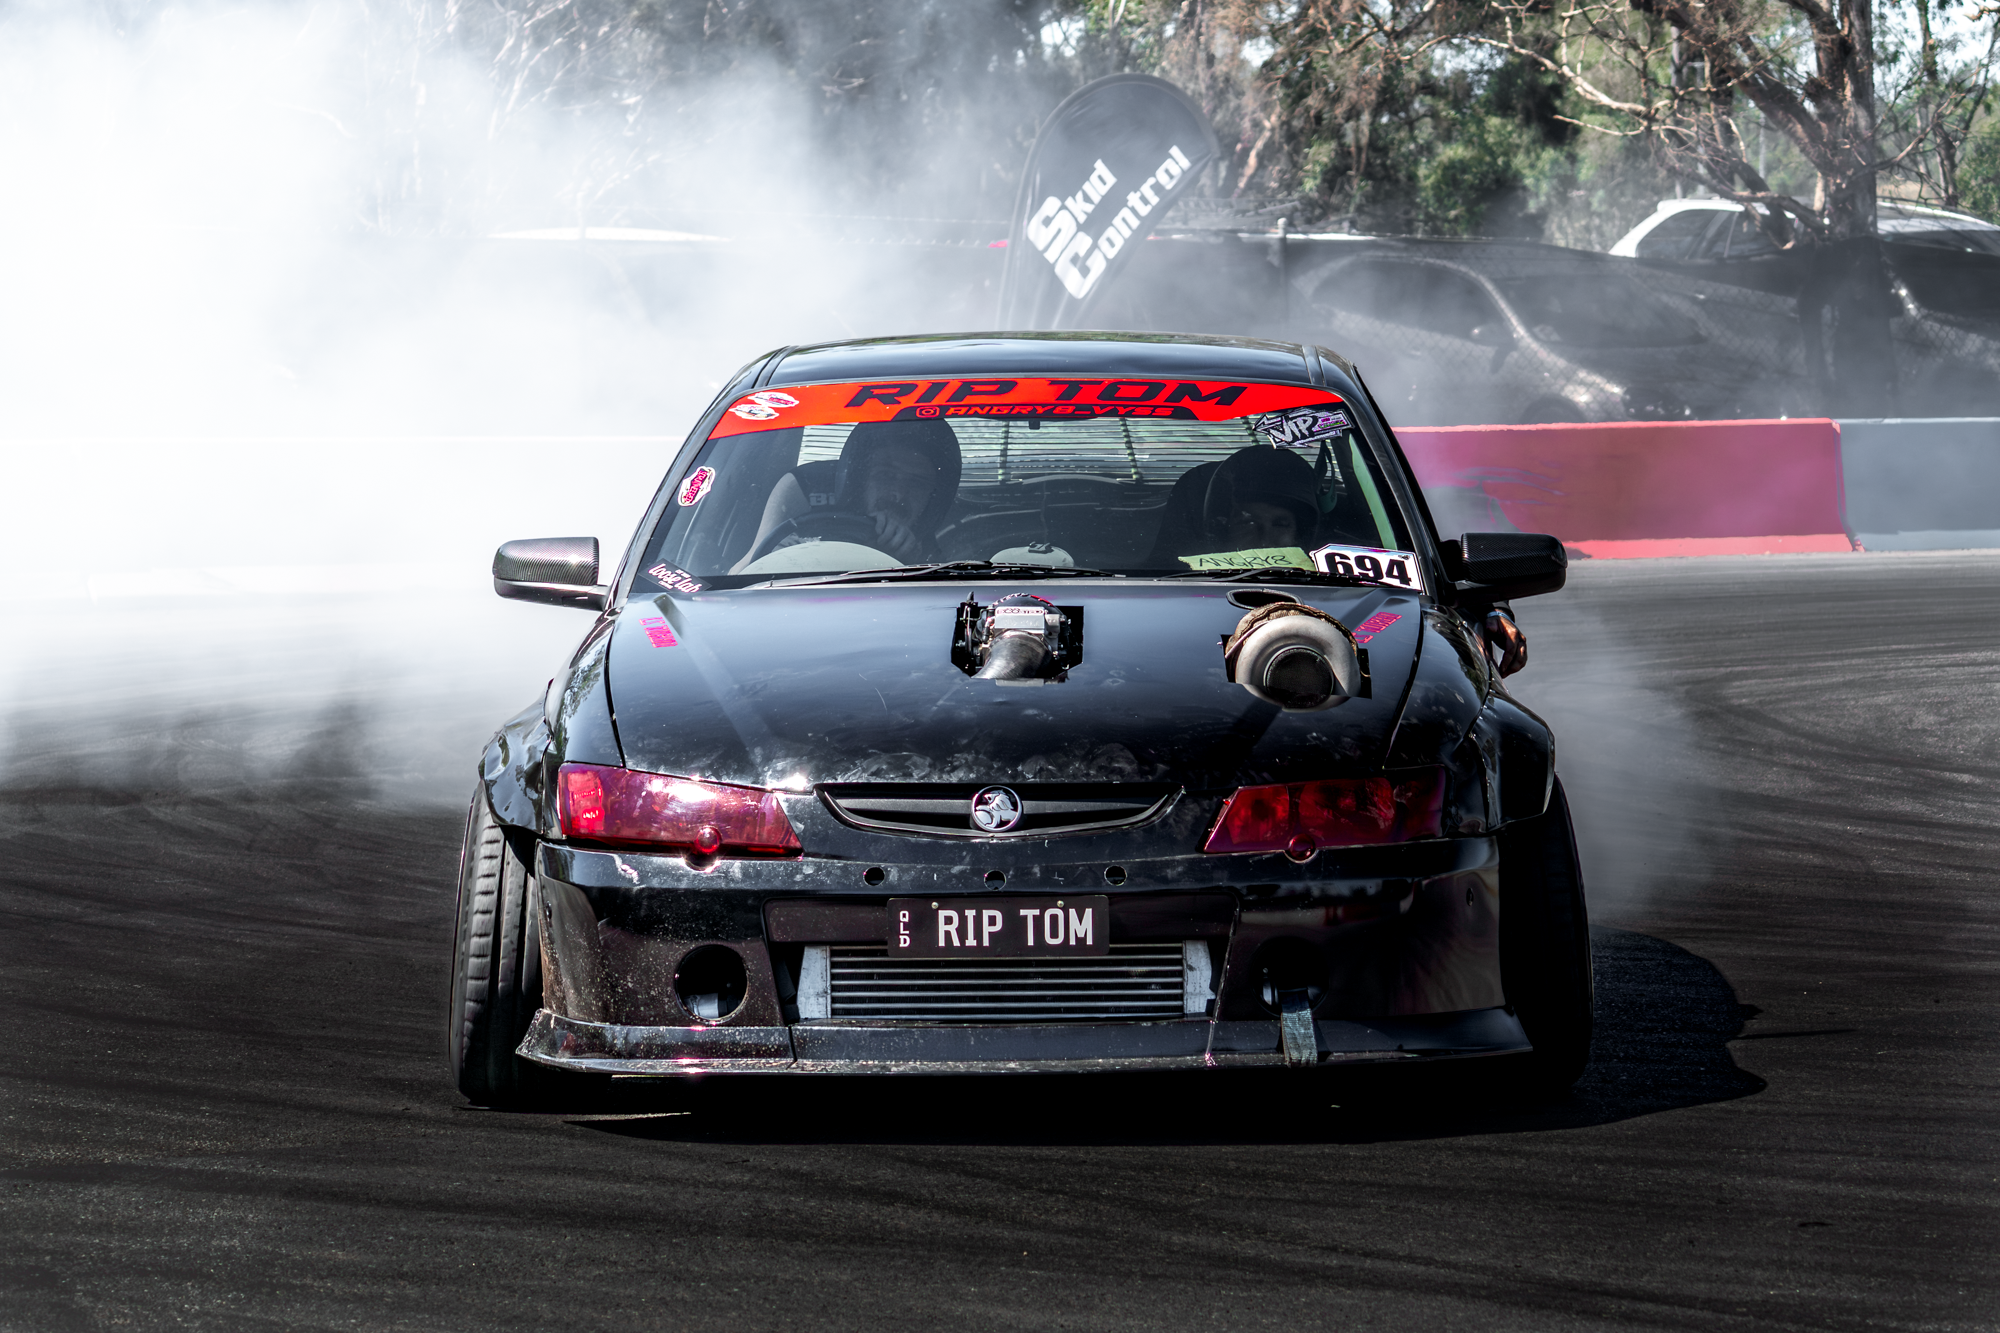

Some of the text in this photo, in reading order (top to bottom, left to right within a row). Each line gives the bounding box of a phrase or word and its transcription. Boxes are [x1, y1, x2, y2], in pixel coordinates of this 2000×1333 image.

[1026, 158, 1118, 264] Skid
[1054, 144, 1192, 300] Control
[844, 379, 1249, 408] RIP TOM
[1323, 551, 1412, 586] 694
[899, 910, 911, 948] QLD
[937, 908, 1093, 947] RIP TOM
